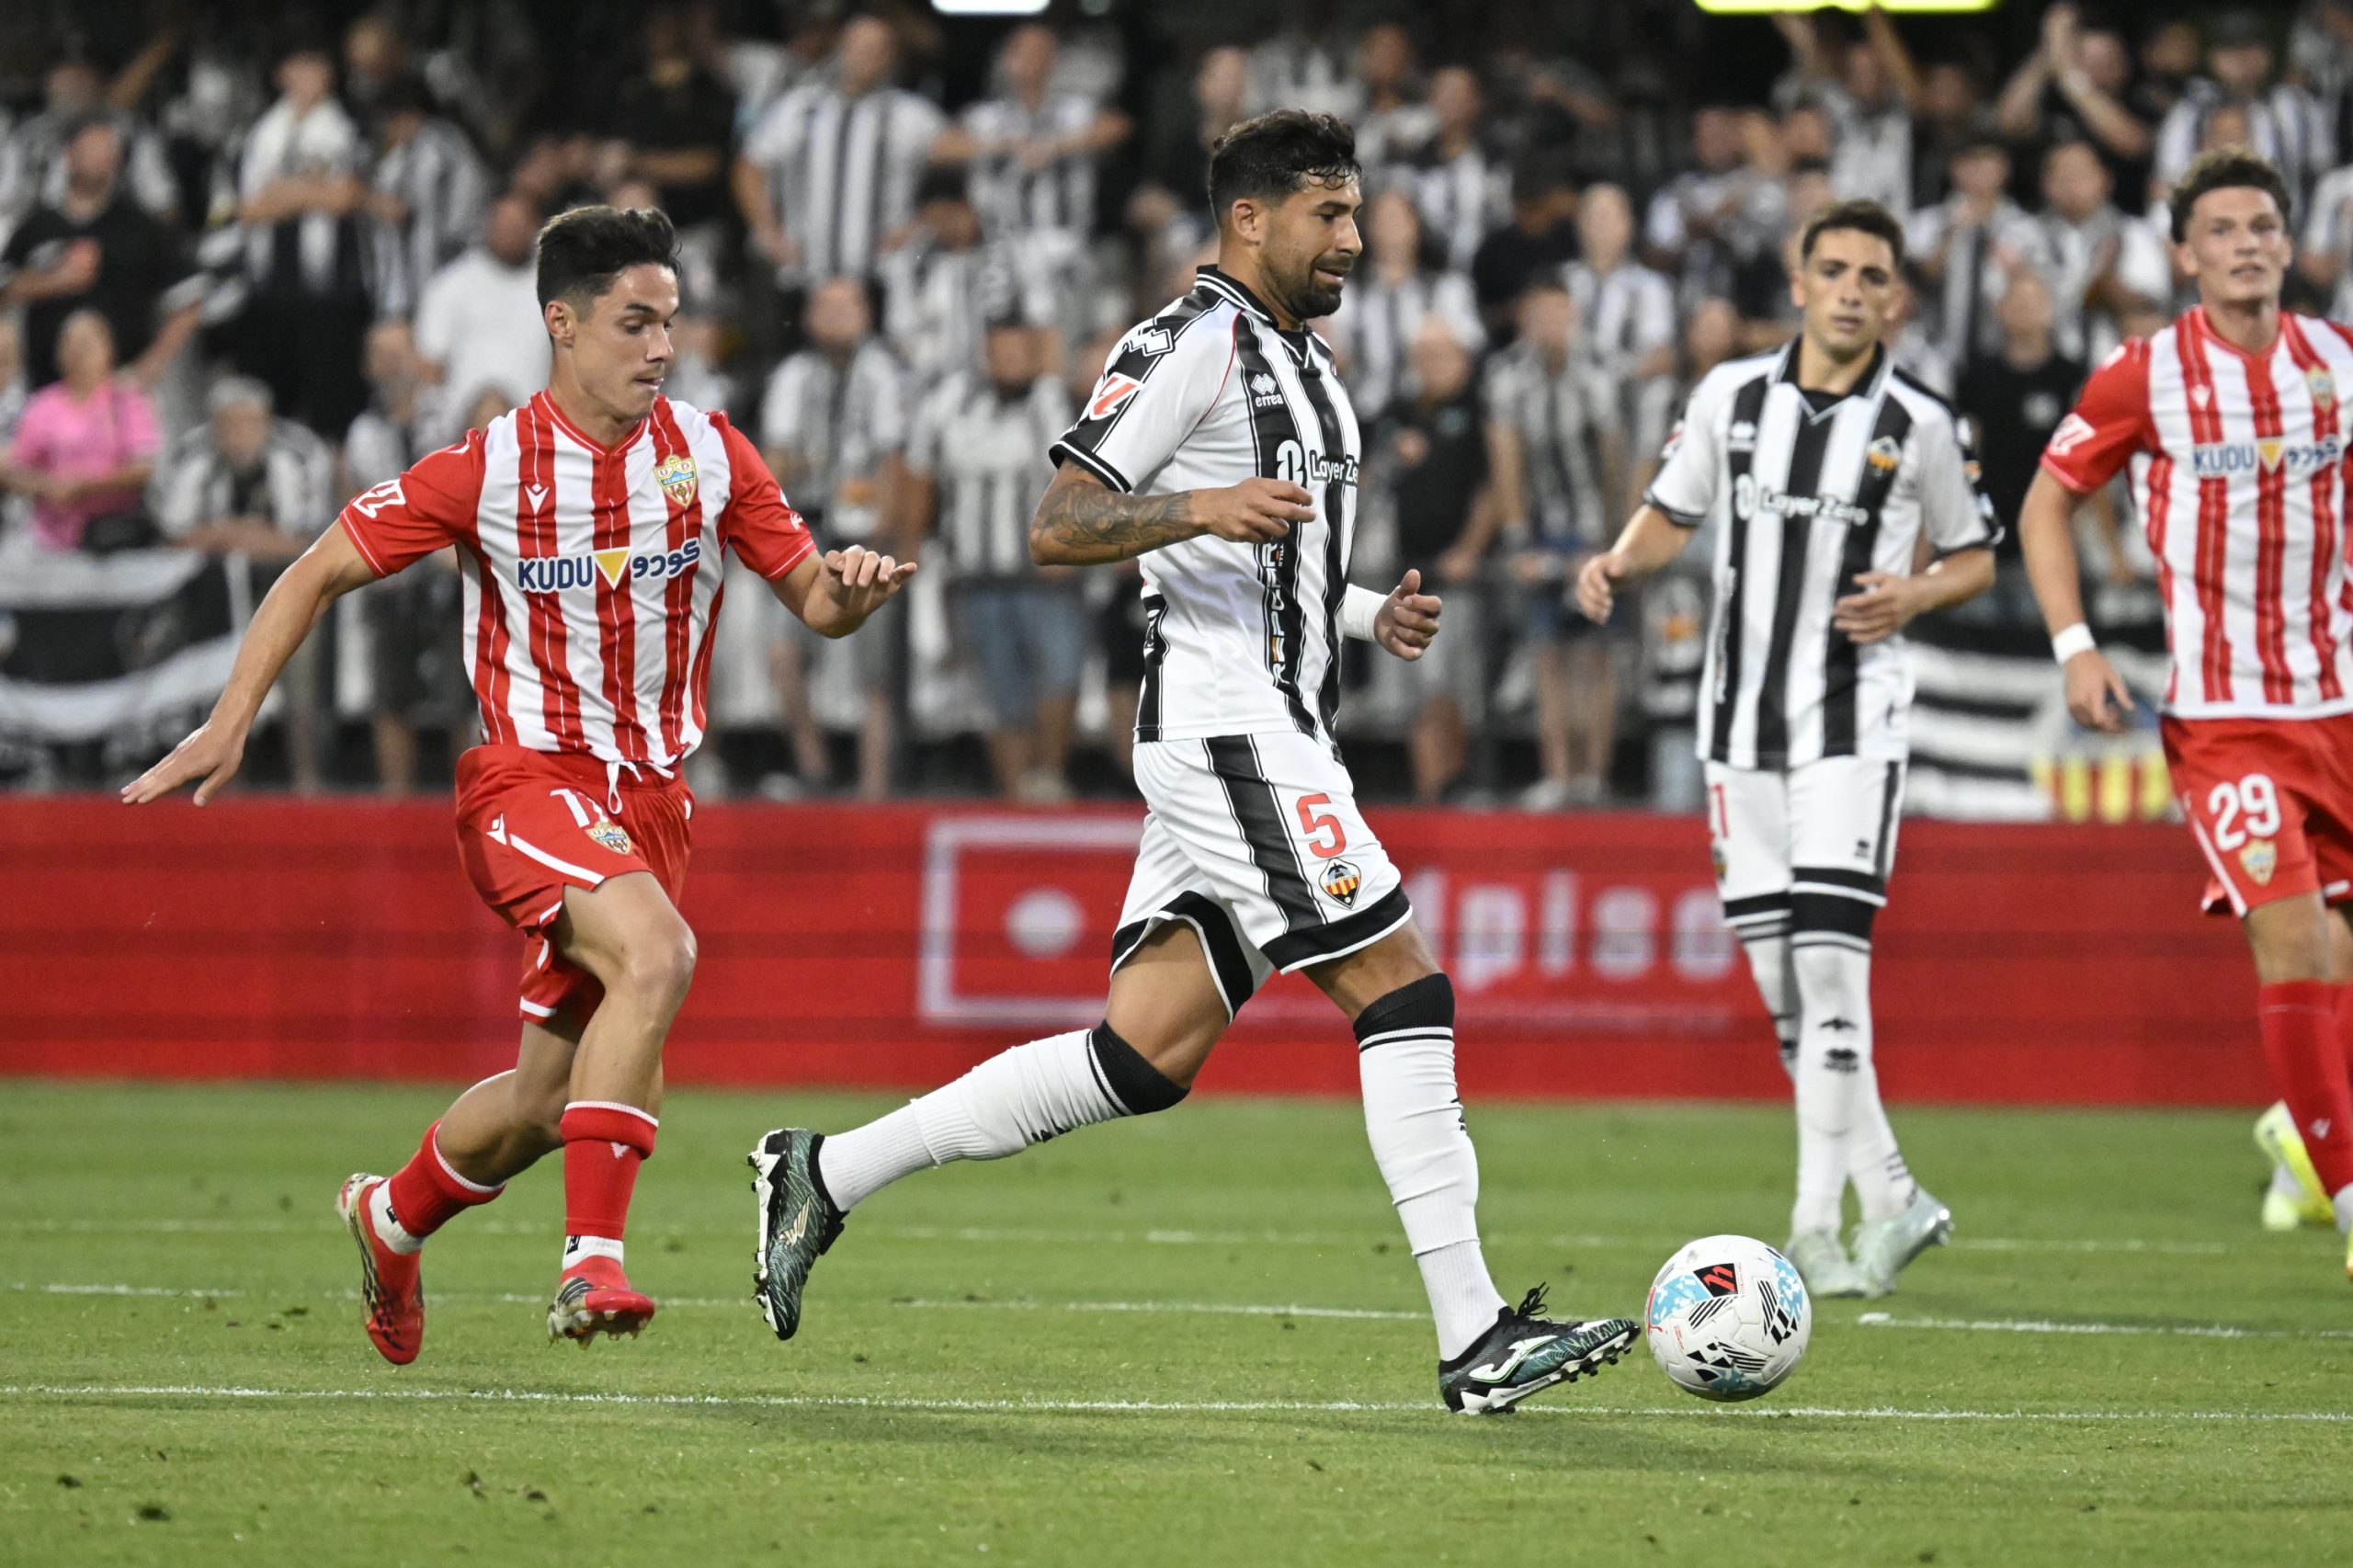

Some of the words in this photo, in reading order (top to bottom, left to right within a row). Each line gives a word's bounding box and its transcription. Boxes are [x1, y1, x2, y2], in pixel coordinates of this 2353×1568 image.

[1255, 393, 1284, 407] errea
[2193, 444, 2255, 472] KUDU
[518, 555, 594, 590] KUDU
[1295, 792, 1347, 858] 5
[2208, 772, 2281, 852] 29
